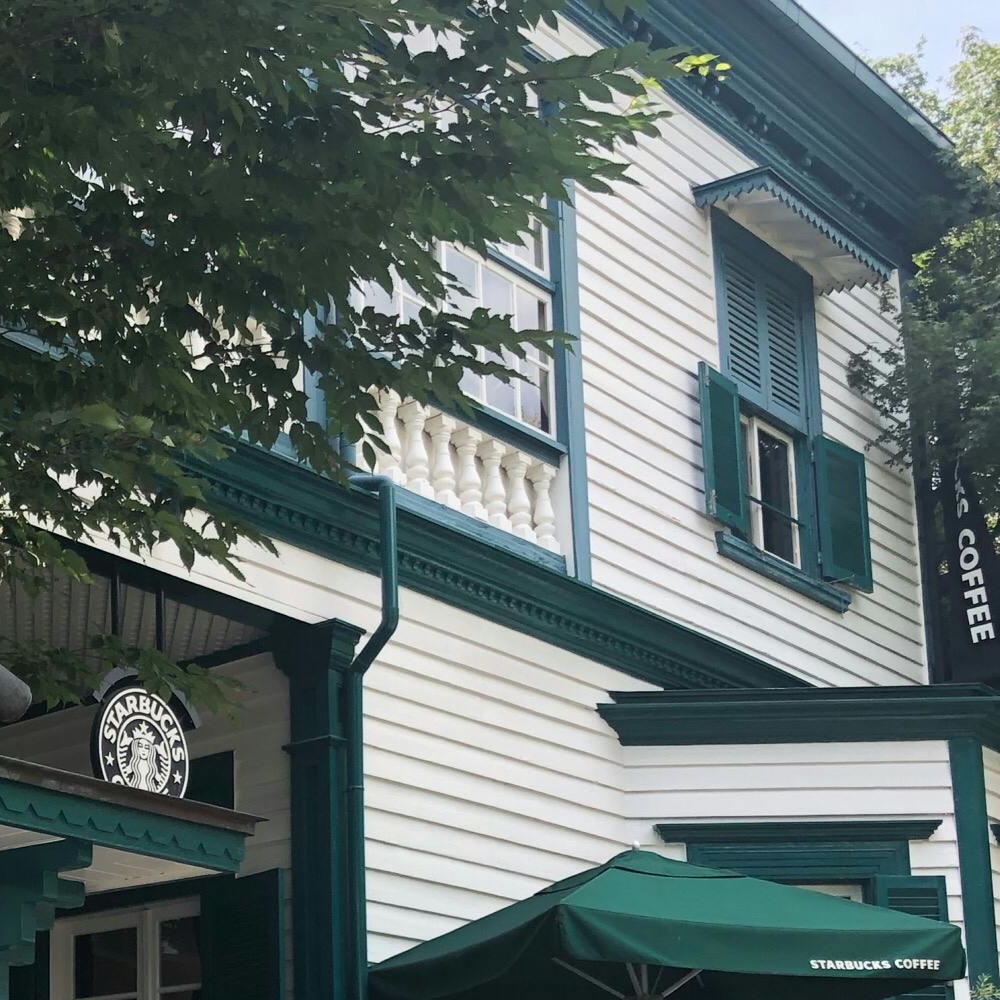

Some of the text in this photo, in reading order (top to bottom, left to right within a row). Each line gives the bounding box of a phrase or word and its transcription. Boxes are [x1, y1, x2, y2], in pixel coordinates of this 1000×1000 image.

[958, 528, 996, 644] COFFEE
[103, 695, 185, 762] STARBUCKS
[809, 958, 941, 971] STARBUCKS COFFEE
